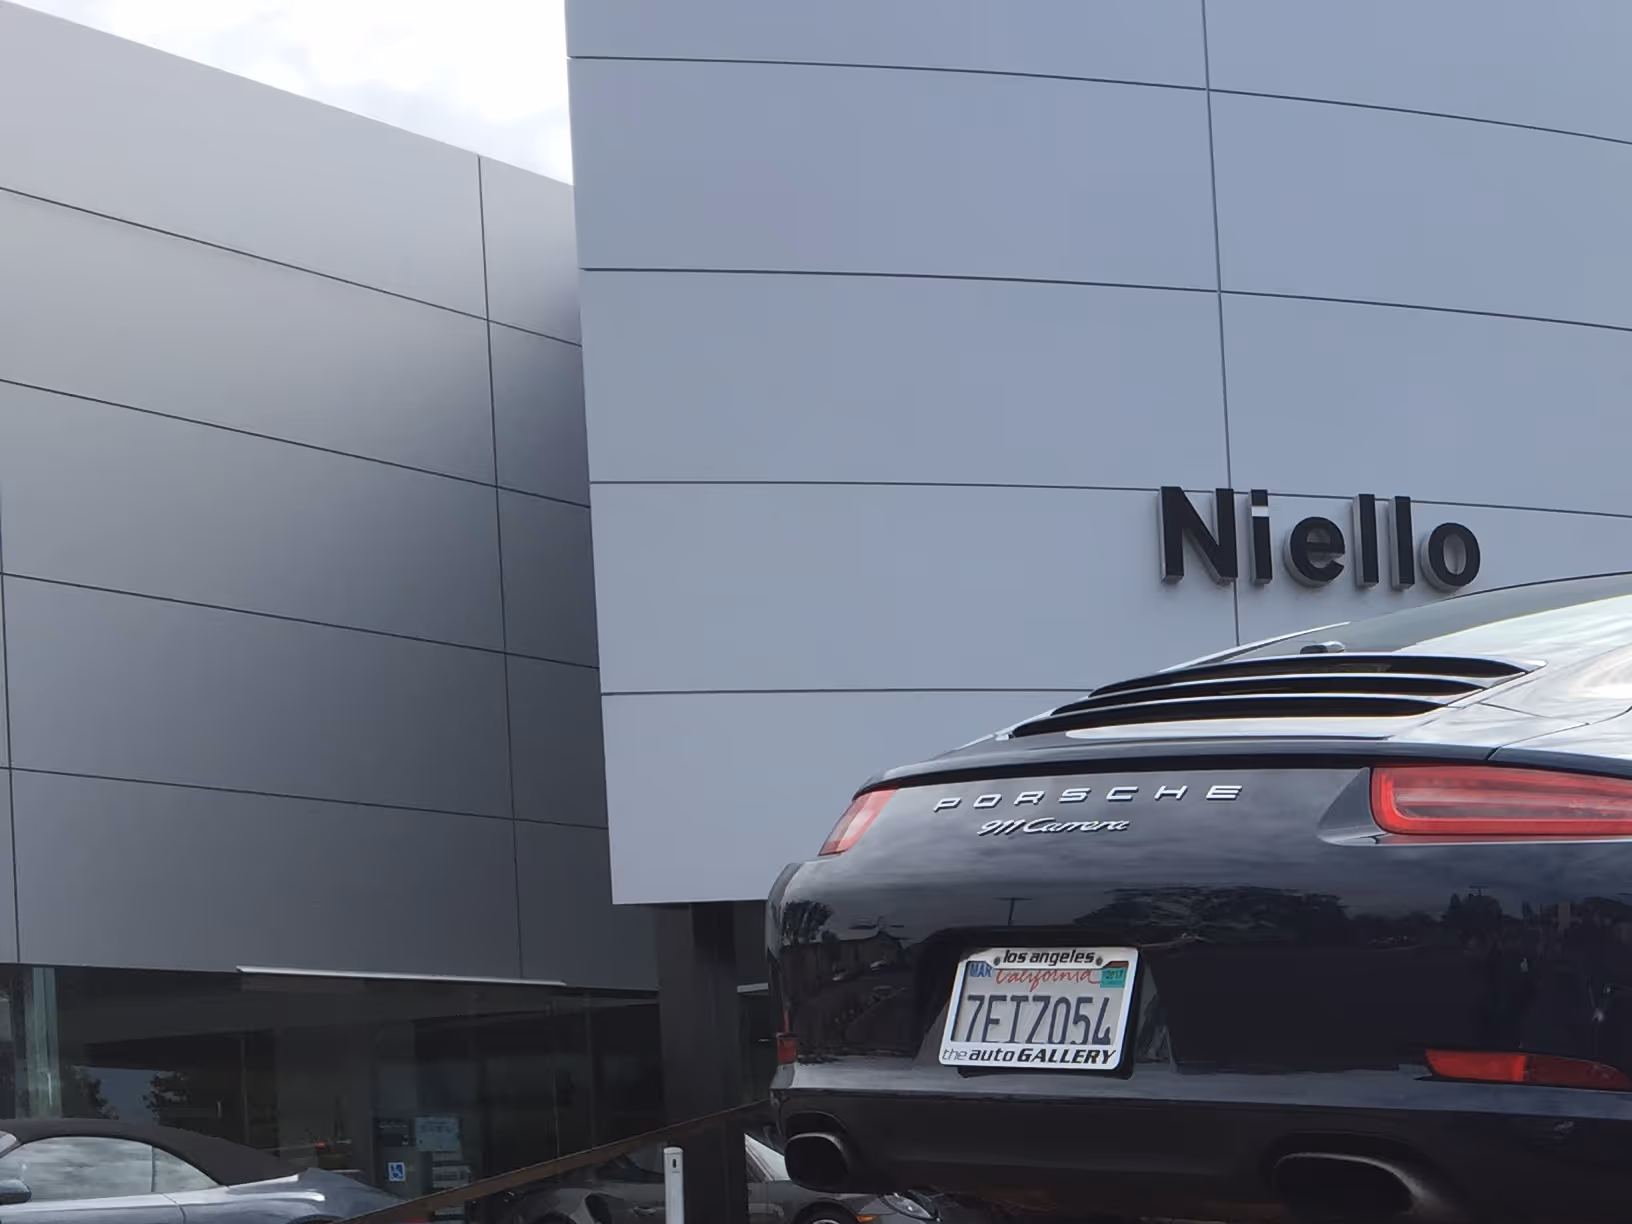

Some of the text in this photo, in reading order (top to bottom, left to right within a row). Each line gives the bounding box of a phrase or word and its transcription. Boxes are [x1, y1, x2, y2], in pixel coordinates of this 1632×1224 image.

[1158, 486, 1481, 589] Niello
[933, 784, 1243, 812] PORSCHE
[1003, 949, 1096, 967] los angeles
[942, 1048, 1117, 1065] the auto GALLERY
